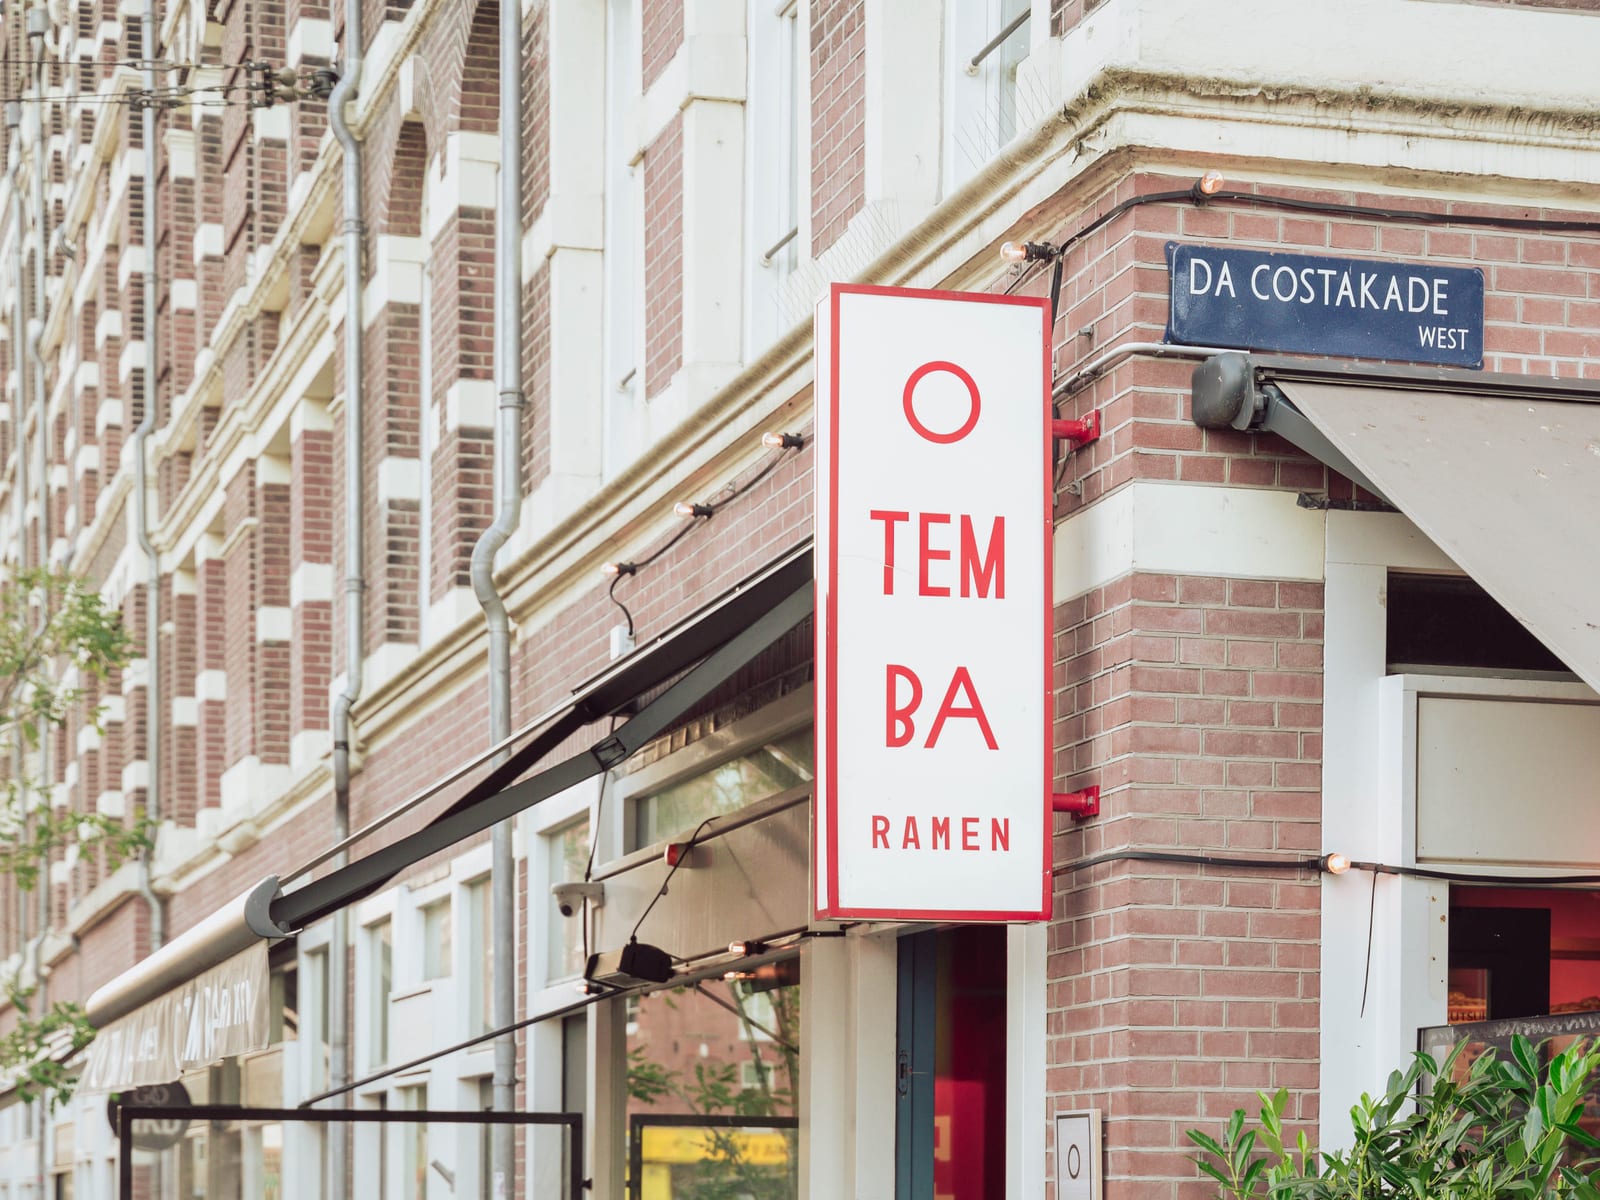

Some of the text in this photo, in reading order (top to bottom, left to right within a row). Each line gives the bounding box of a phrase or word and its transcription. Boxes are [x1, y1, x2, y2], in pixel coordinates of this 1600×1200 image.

[1190, 257, 1450, 316] DA COSTAKADE
[1418, 325, 1469, 351] WEST
[902, 360, 982, 445] O
[869, 509, 1006, 600] TEM
[885, 663, 999, 751] BA
[871, 815, 1010, 852] RAMEN
[1067, 1143, 1081, 1180] O
